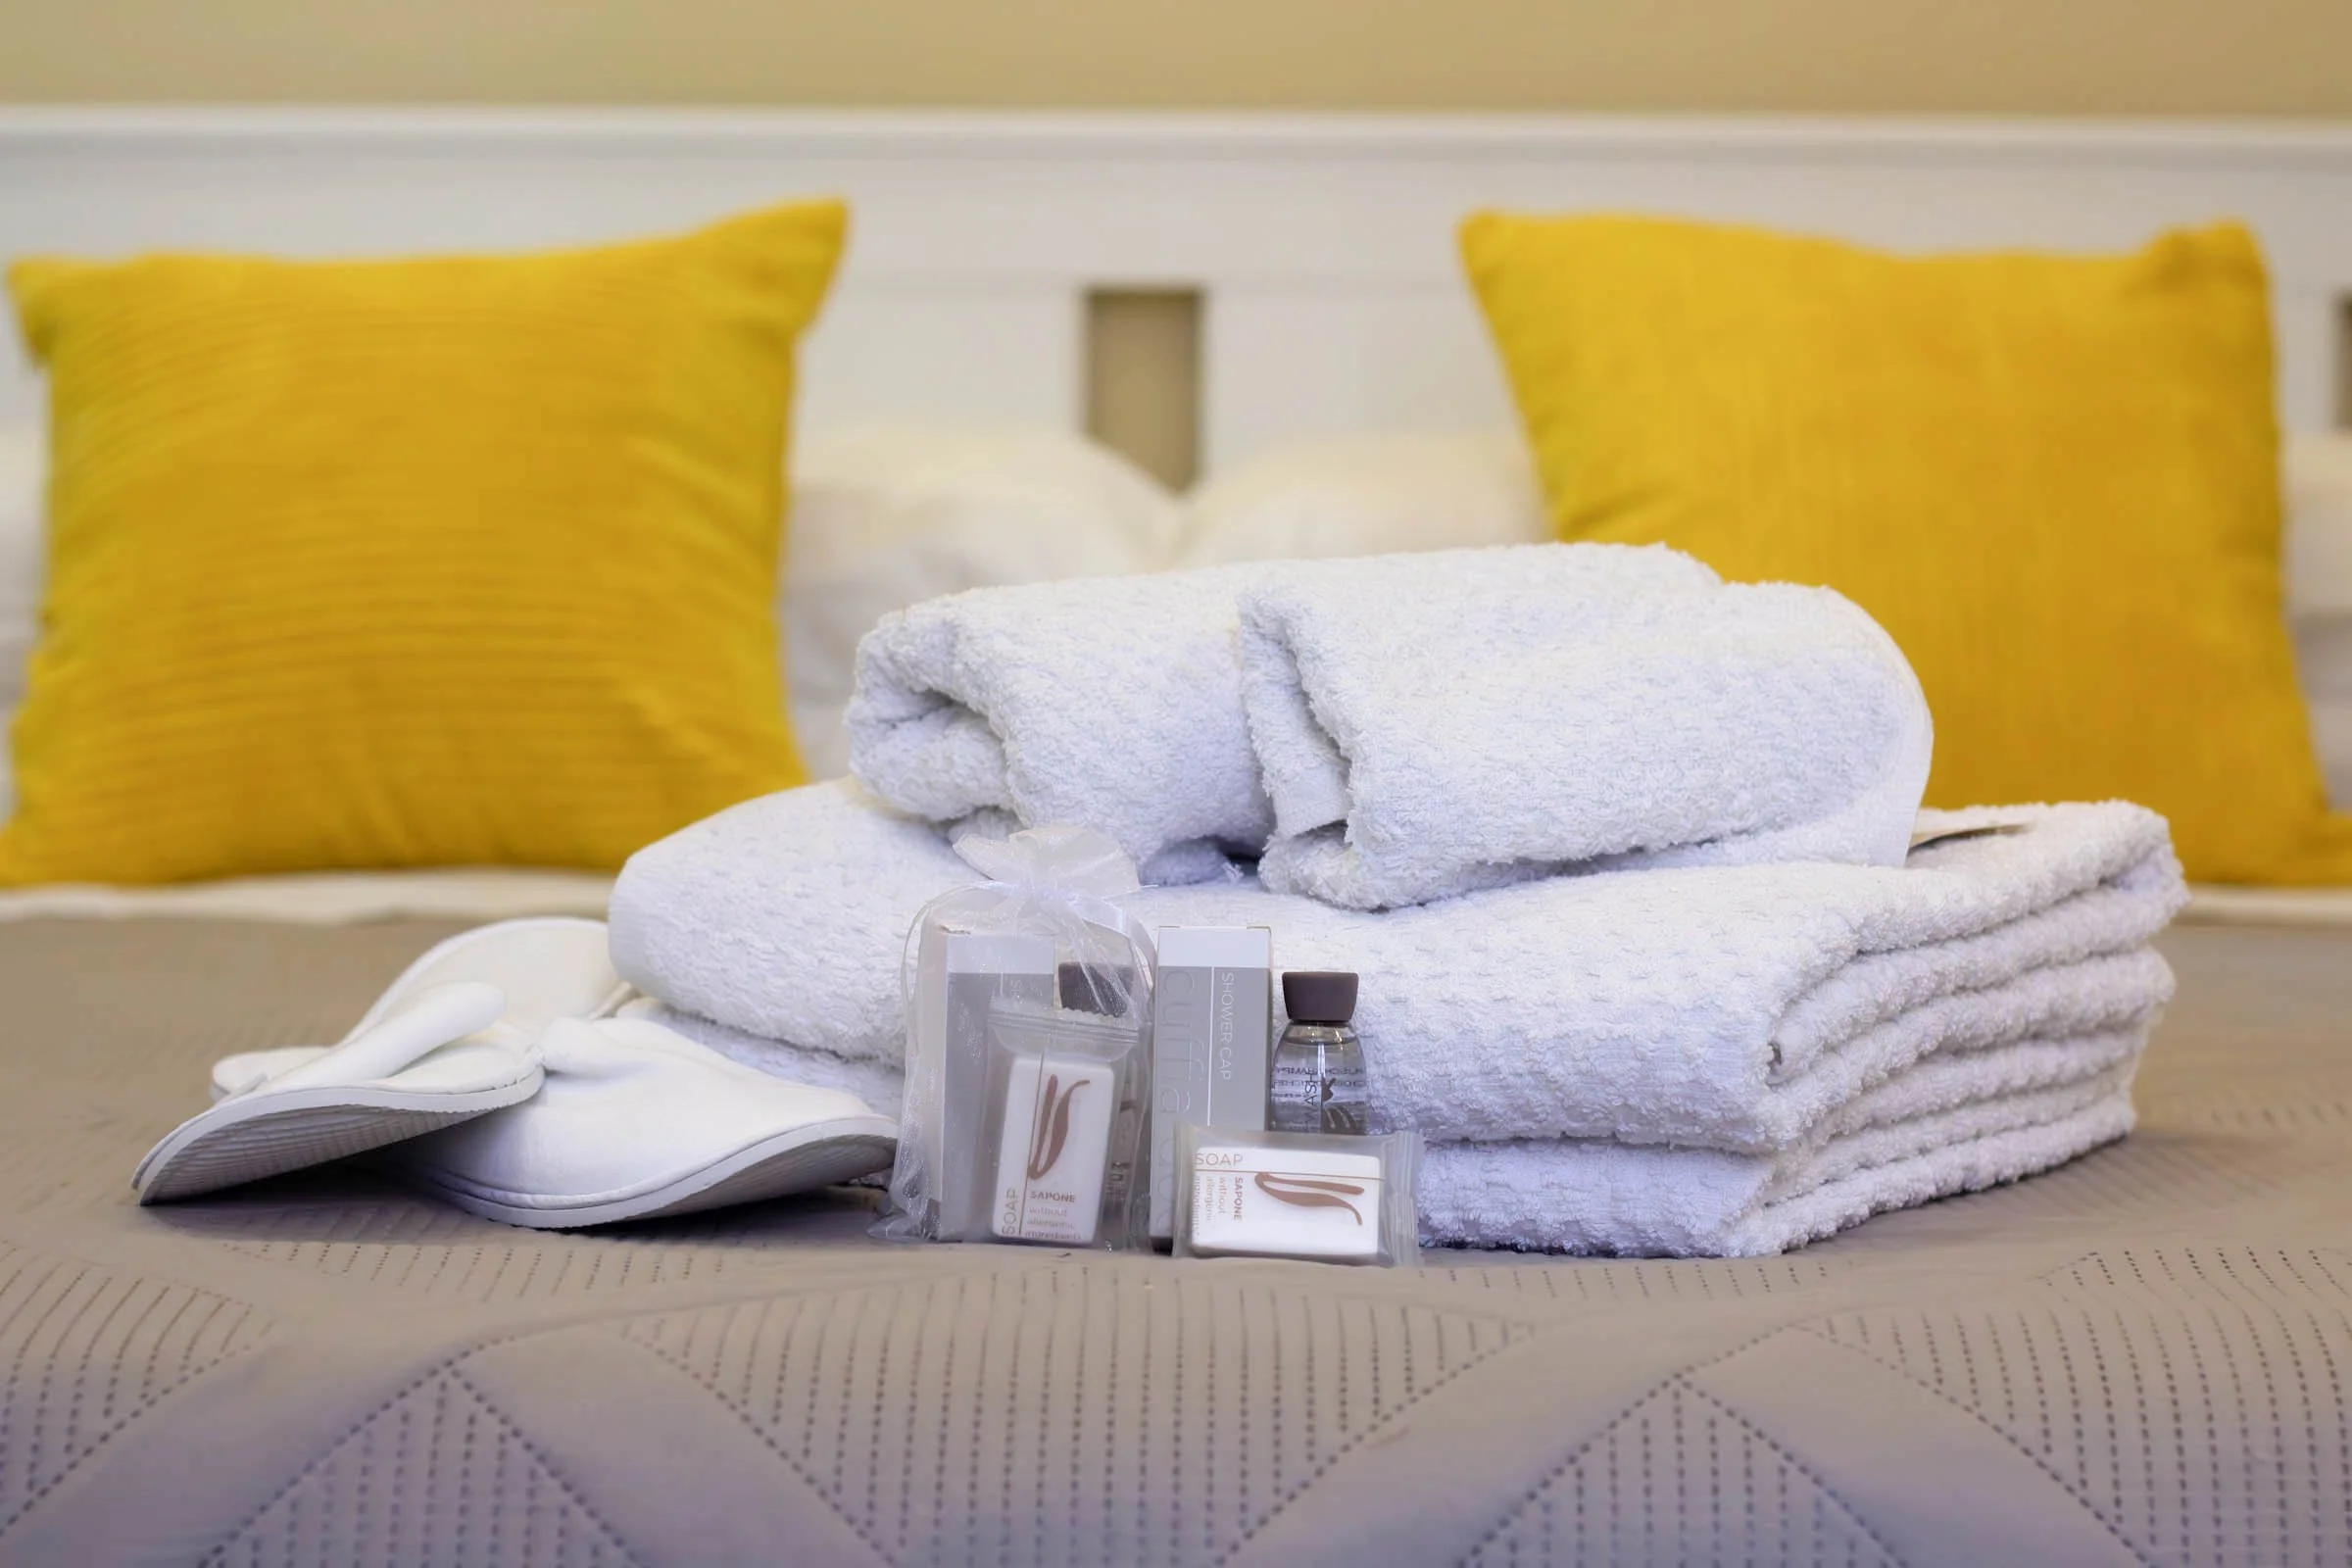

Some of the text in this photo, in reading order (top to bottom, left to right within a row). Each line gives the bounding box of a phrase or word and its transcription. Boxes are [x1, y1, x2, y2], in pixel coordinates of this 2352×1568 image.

[1218, 972, 1235, 1080] SHOWER CAP
[1195, 1152, 1244, 1166] SOAP
[1002, 1188, 1018, 1235] SOAP
[1028, 1191, 1075, 1202] SAPONE
[1234, 1177, 1244, 1221] SAPONE
